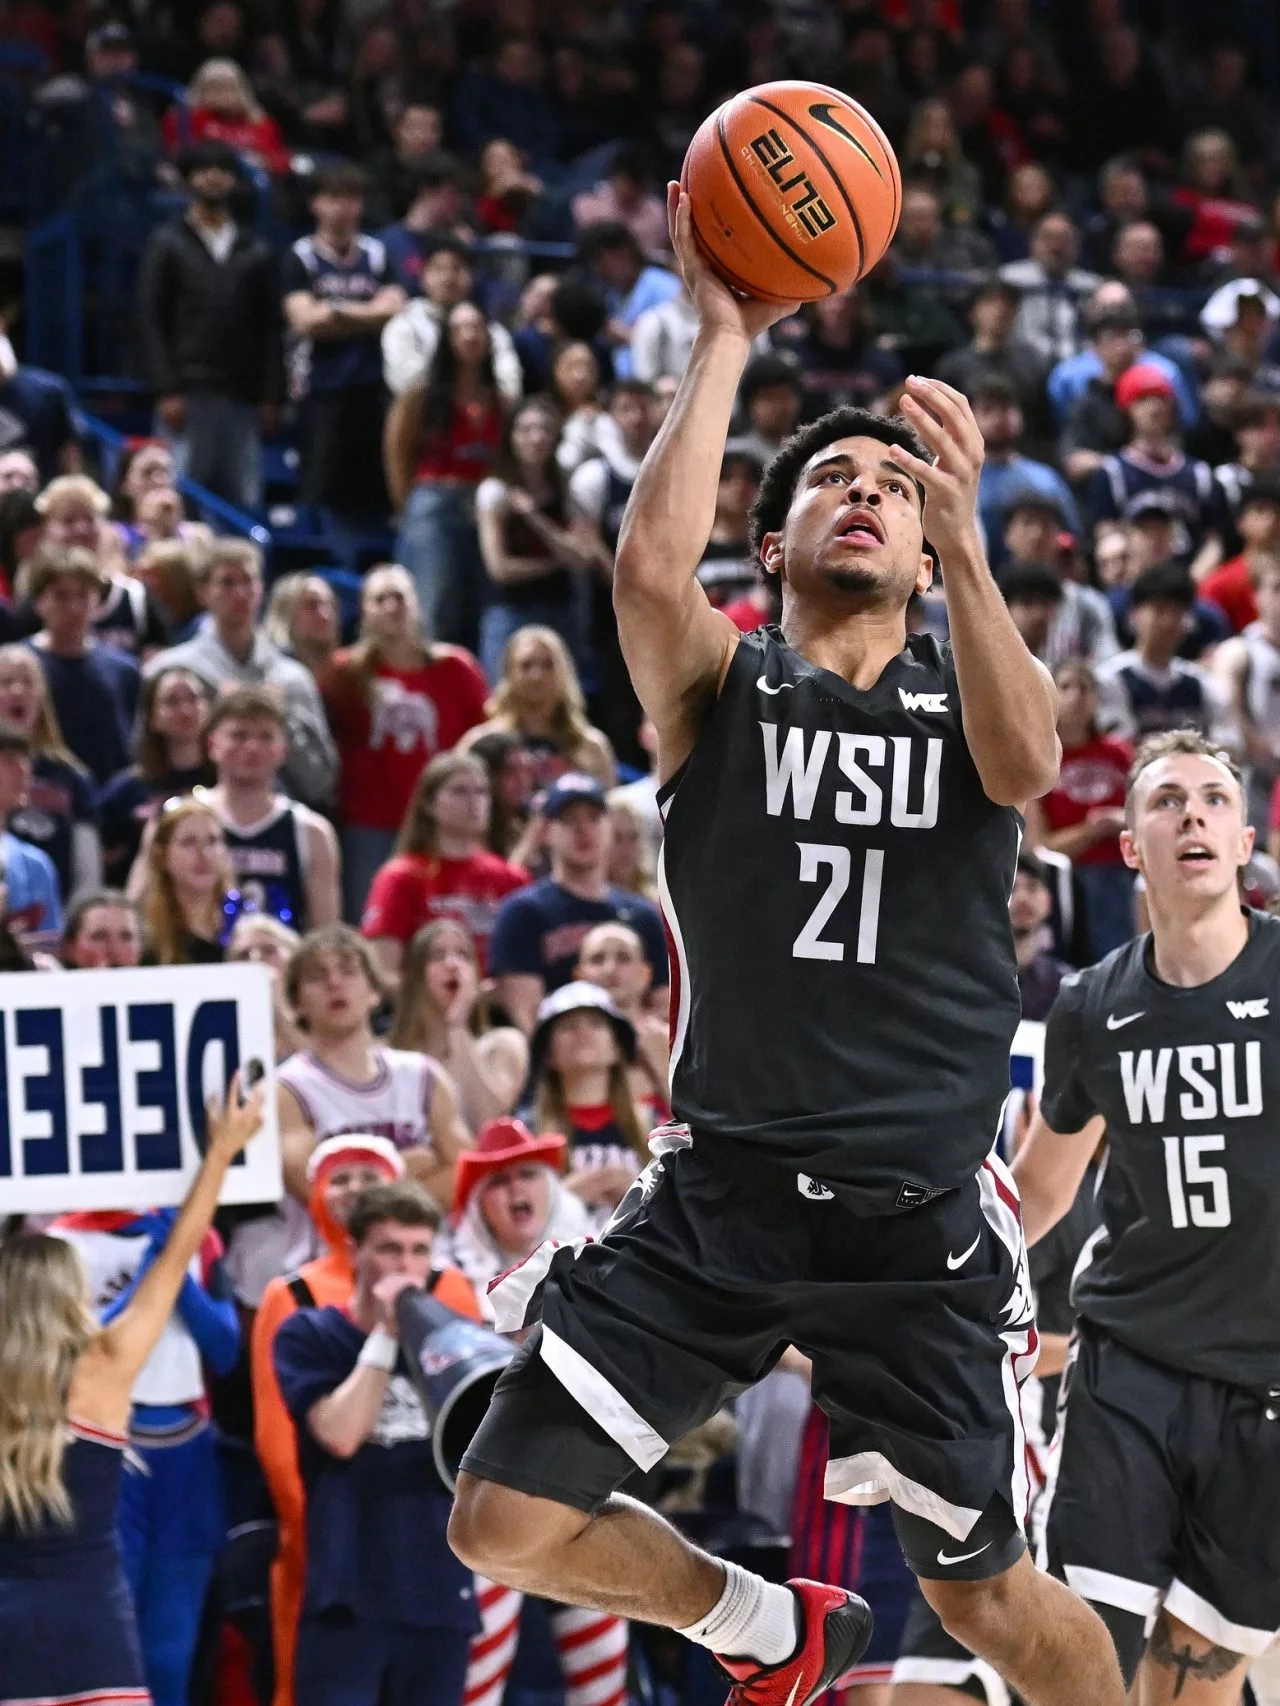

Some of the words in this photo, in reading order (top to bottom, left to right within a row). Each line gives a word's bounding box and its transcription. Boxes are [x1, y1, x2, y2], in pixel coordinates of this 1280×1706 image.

[750, 128, 837, 240] ELITE
[758, 721, 943, 829] WSU
[792, 841, 885, 964] 21
[0, 1000, 246, 1177] DEFE
[1118, 1041, 1263, 1124] WSU
[1161, 1134, 1231, 1229] 15
